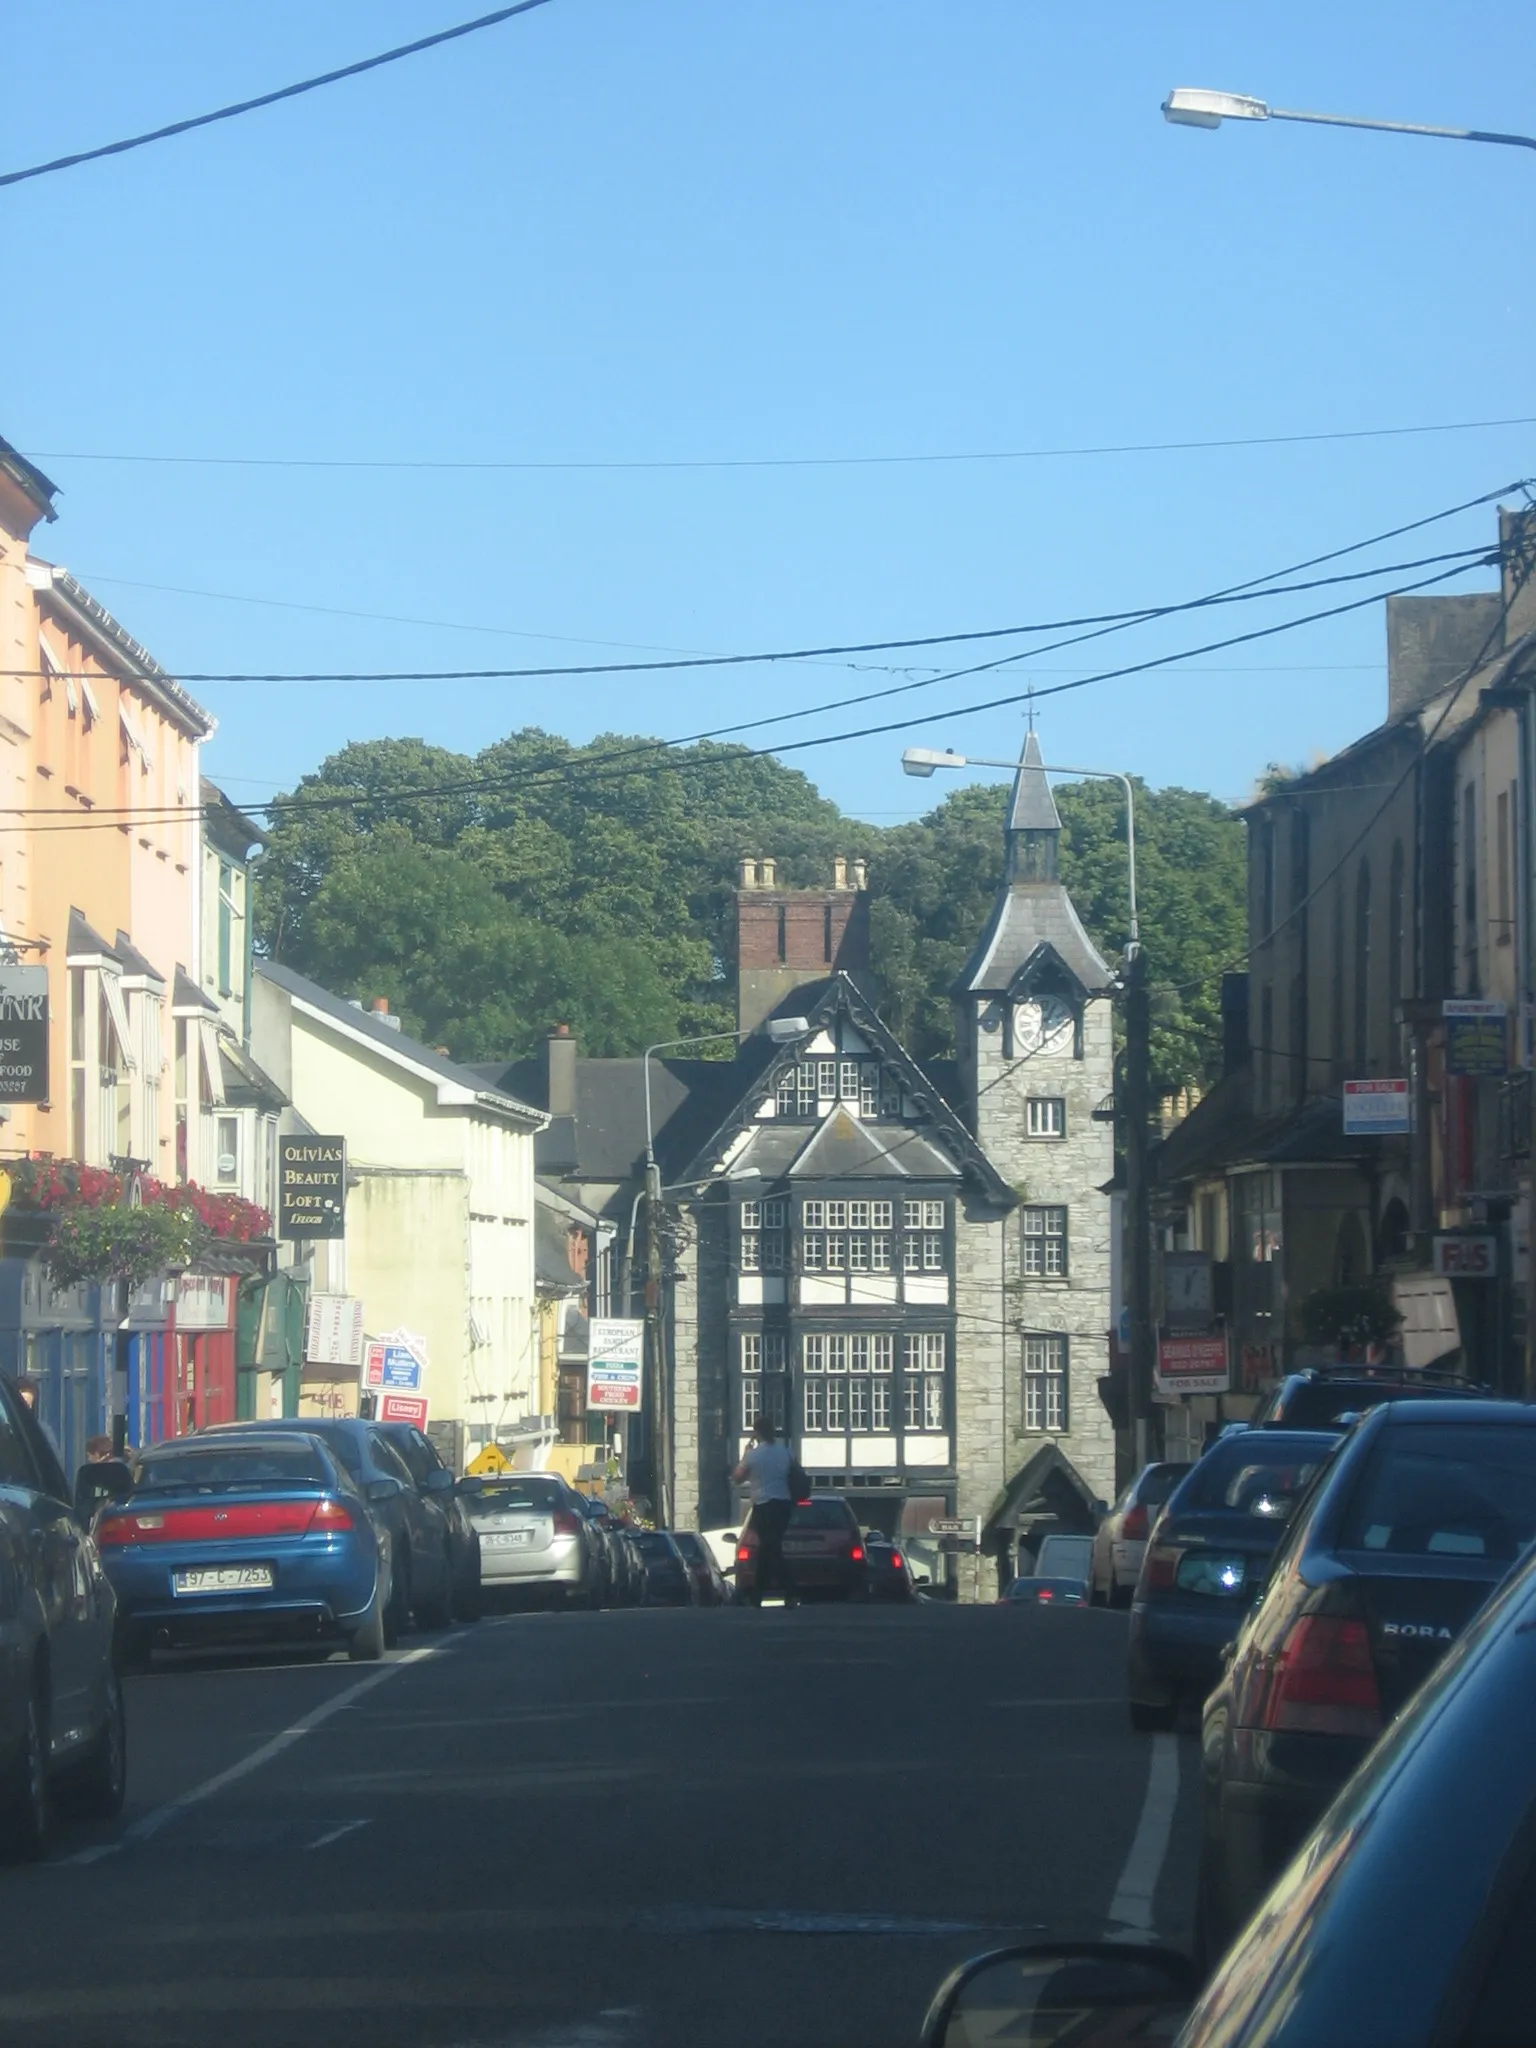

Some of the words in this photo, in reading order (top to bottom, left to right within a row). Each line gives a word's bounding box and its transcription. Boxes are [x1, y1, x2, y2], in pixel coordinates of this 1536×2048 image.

[283, 1169, 340, 1185] BEAUTY
[283, 1192, 322, 1208] LOFT
[1168, 1379, 1191, 1388] FOR
[1193, 1378, 1218, 1388] SALE
[1383, 1623, 1452, 1638] BORA
